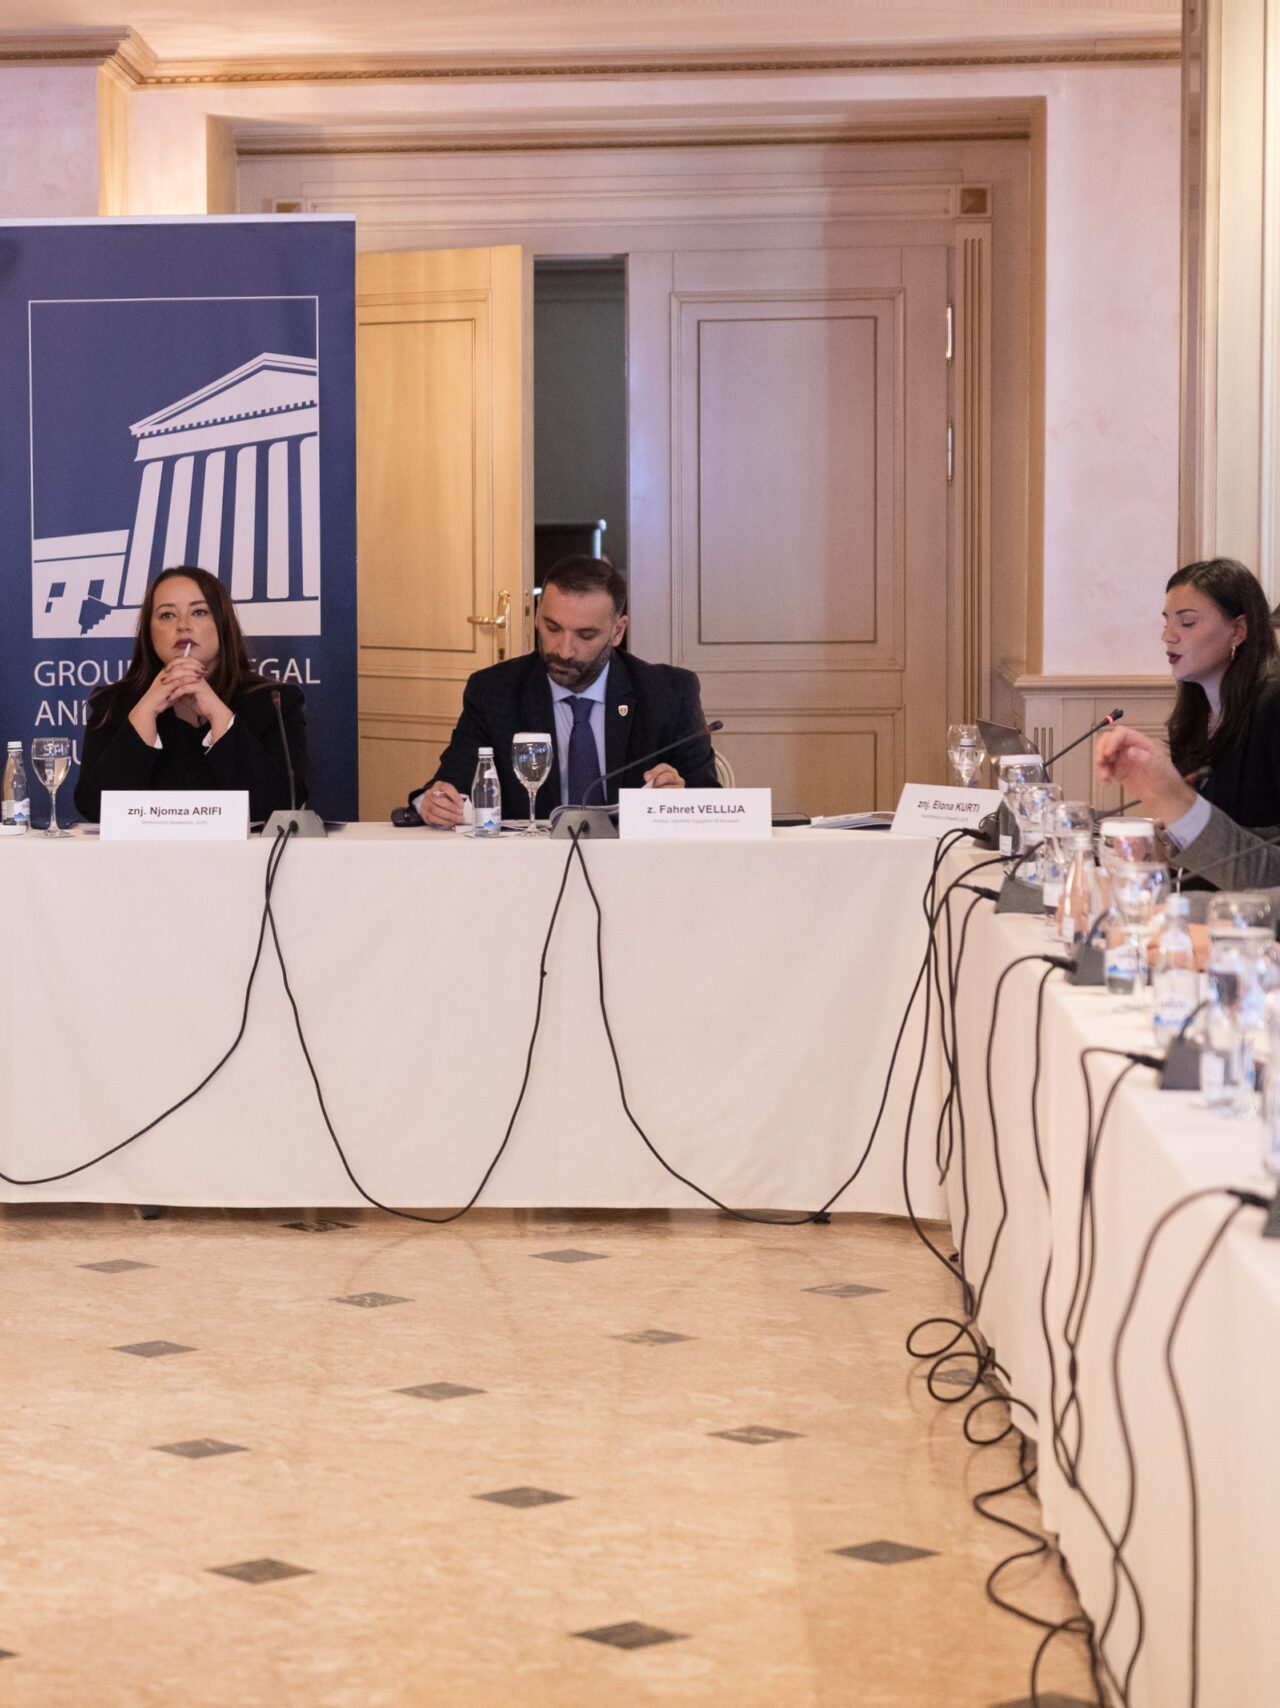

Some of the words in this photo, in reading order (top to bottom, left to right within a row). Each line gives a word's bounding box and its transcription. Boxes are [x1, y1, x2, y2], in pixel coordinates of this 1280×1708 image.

[34, 659, 132, 687] GROU
[248, 657, 321, 684] GAL
[127, 806, 146, 817] znj.
[149, 806, 190, 817] Njomza
[192, 806, 222, 815] ARIFI
[646, 806, 656, 814] z.
[659, 804, 695, 814] Fahret
[698, 804, 746, 814] VELLIJA
[955, 802, 980, 813] KURTI
